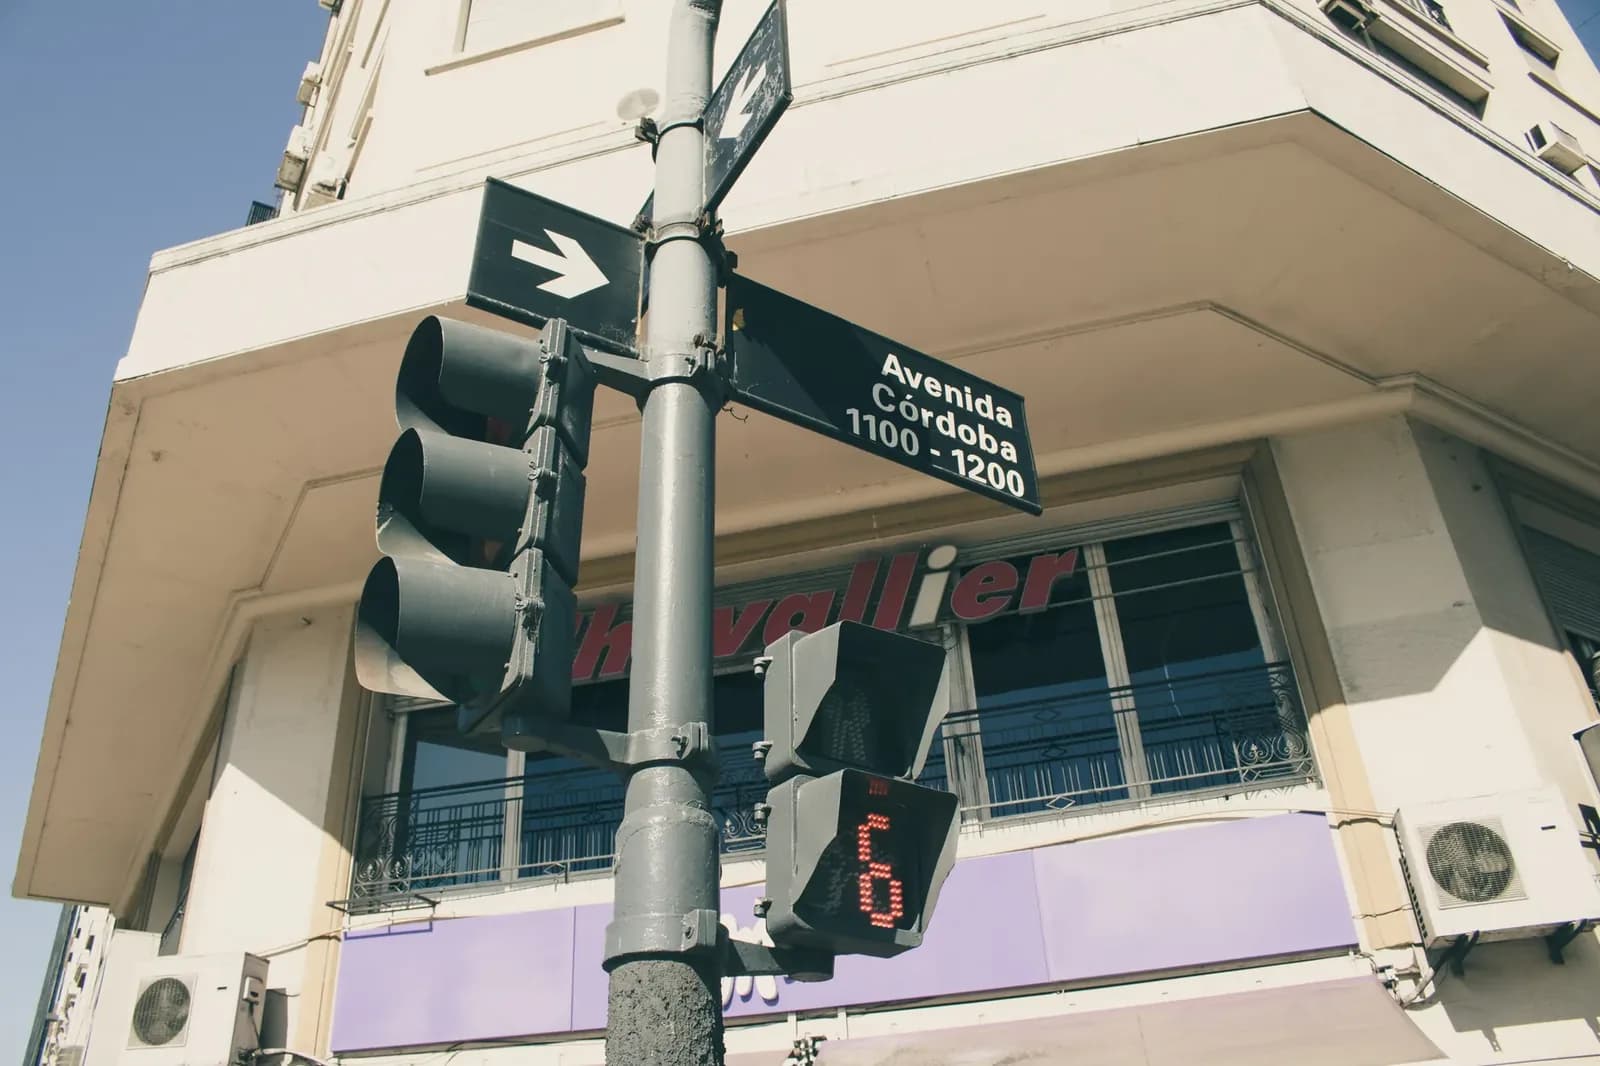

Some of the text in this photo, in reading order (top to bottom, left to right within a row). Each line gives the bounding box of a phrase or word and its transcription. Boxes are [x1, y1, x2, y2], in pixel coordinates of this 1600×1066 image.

[872, 383, 1018, 464] Córdoba
[881, 353, 1013, 429] Avenida
[846, 408, 920, 456] 1100
[951, 449, 1025, 498] 1200
[858, 813, 904, 928] 6
